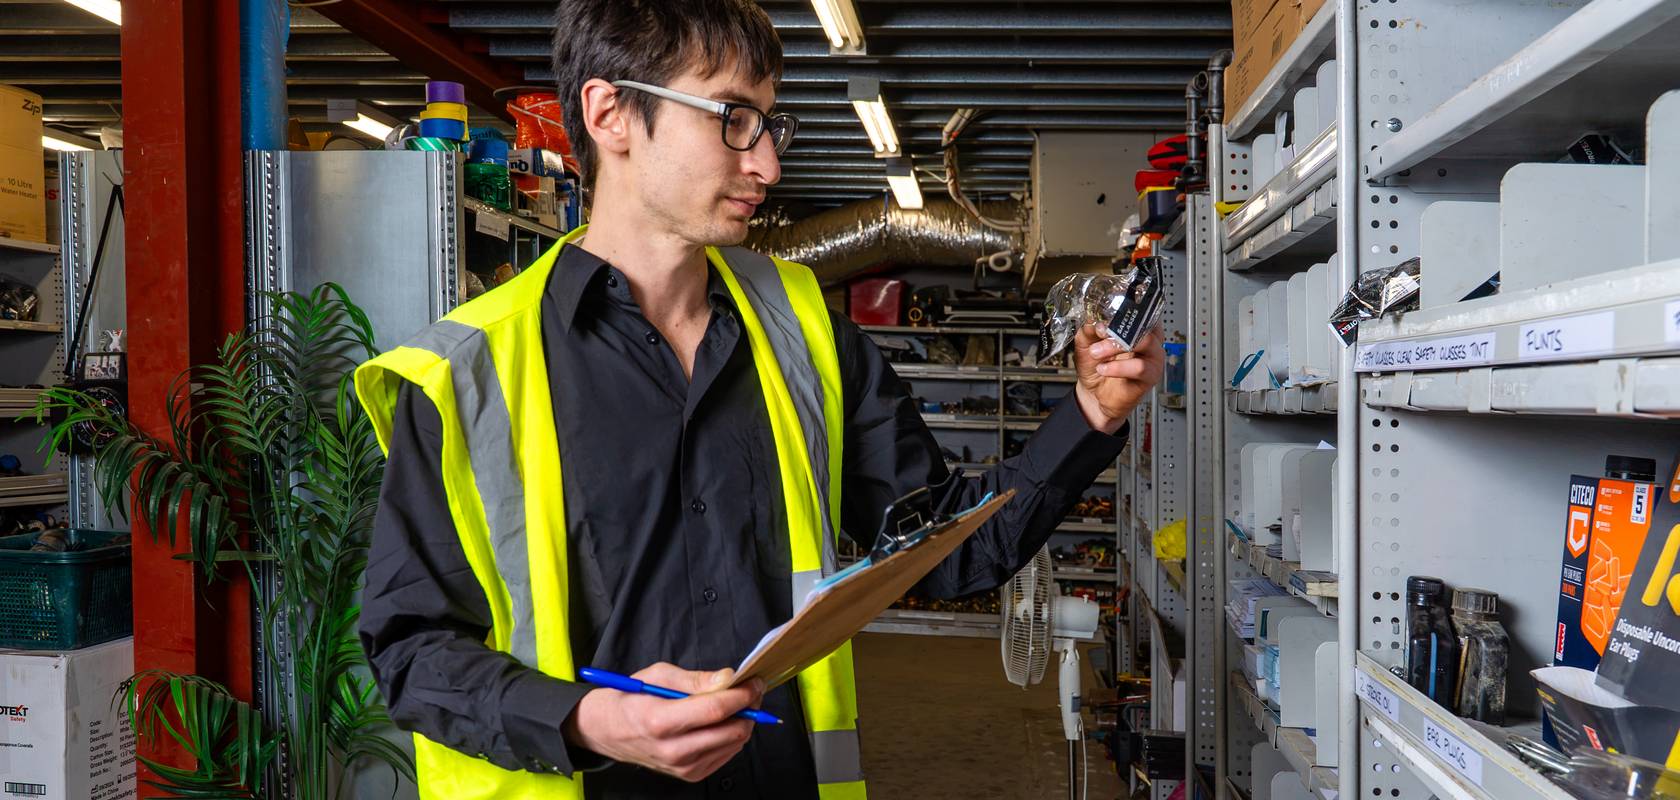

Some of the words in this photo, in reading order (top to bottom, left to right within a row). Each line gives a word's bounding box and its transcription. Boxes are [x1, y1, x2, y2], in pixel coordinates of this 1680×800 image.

[22, 99, 41, 115] Zip
[8, 177, 16, 186] 10
[1117, 308, 1133, 335] SAFETY
[1122, 310, 1139, 339] GLASSES
[1415, 346, 1437, 361] SAFETY
[1439, 344, 1466, 361] GLASSES
[1570, 484, 1595, 506] CITECO
[1635, 494, 1644, 515] 5
[1616, 618, 1654, 643] Disposable
[1609, 637, 1622, 654] Ear
[1619, 641, 1640, 663] Plugs
[1427, 726, 1442, 749] EAR
